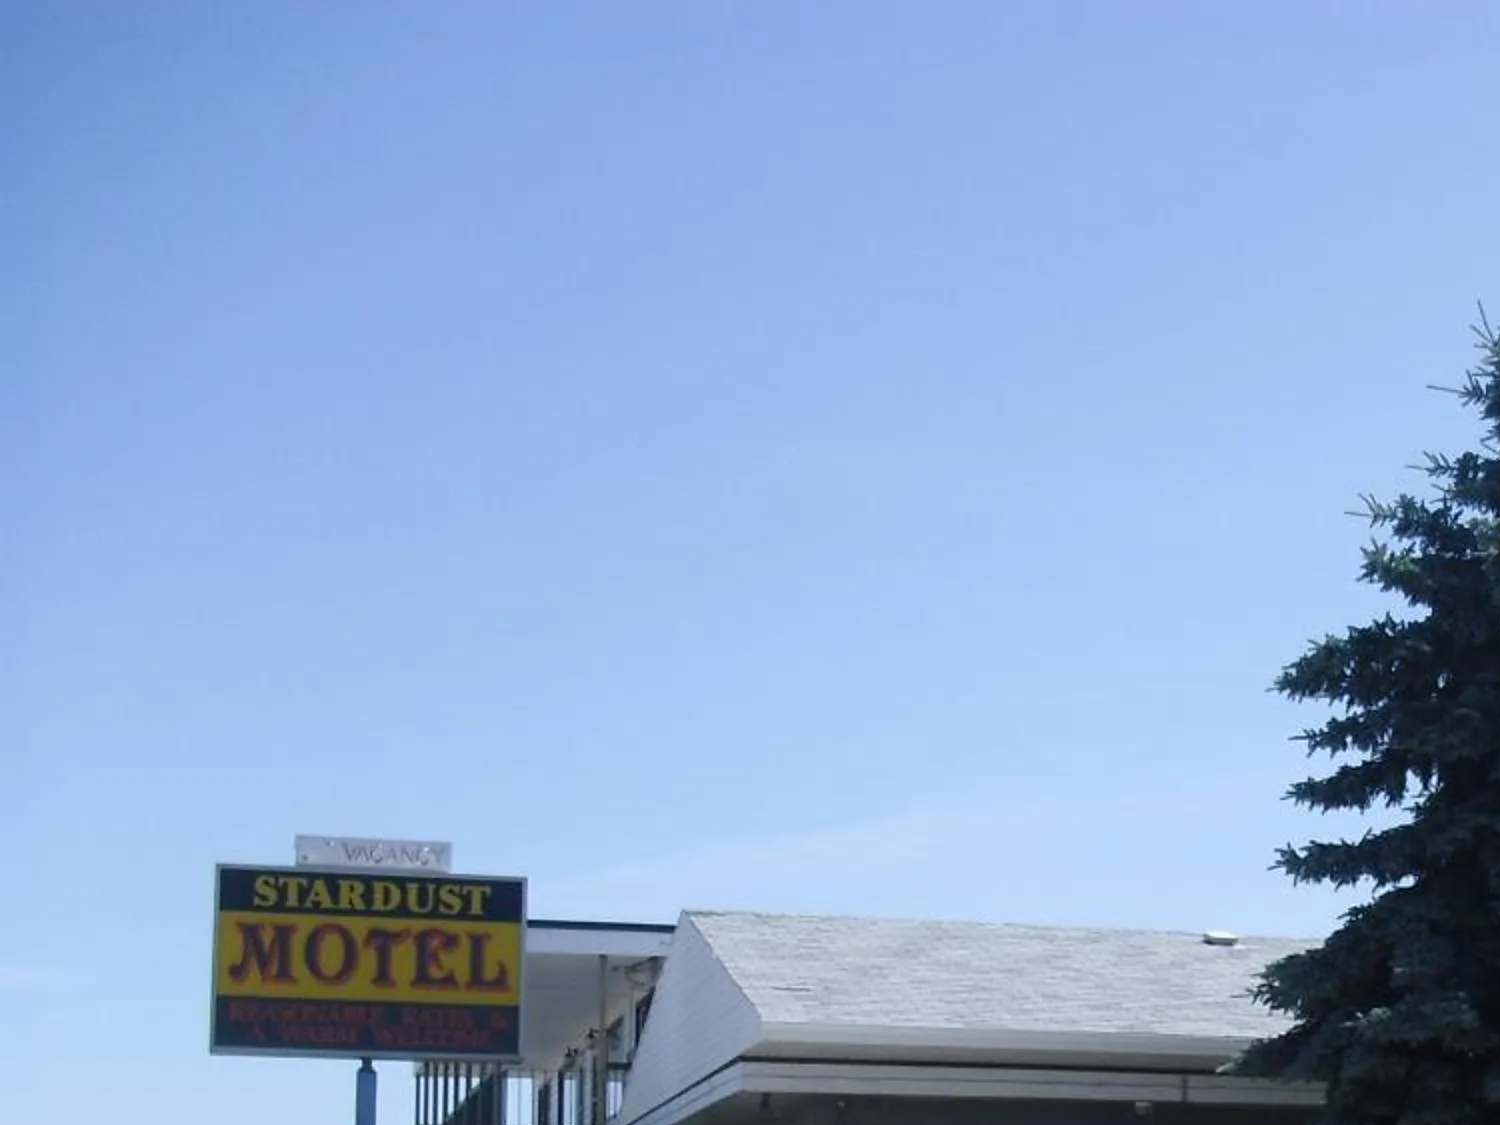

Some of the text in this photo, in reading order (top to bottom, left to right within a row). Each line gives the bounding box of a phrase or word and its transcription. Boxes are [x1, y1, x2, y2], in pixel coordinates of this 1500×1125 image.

[342, 841, 445, 866] VACANCY
[253, 875, 492, 916] STARDUST
[228, 921, 512, 993] MOTEL
